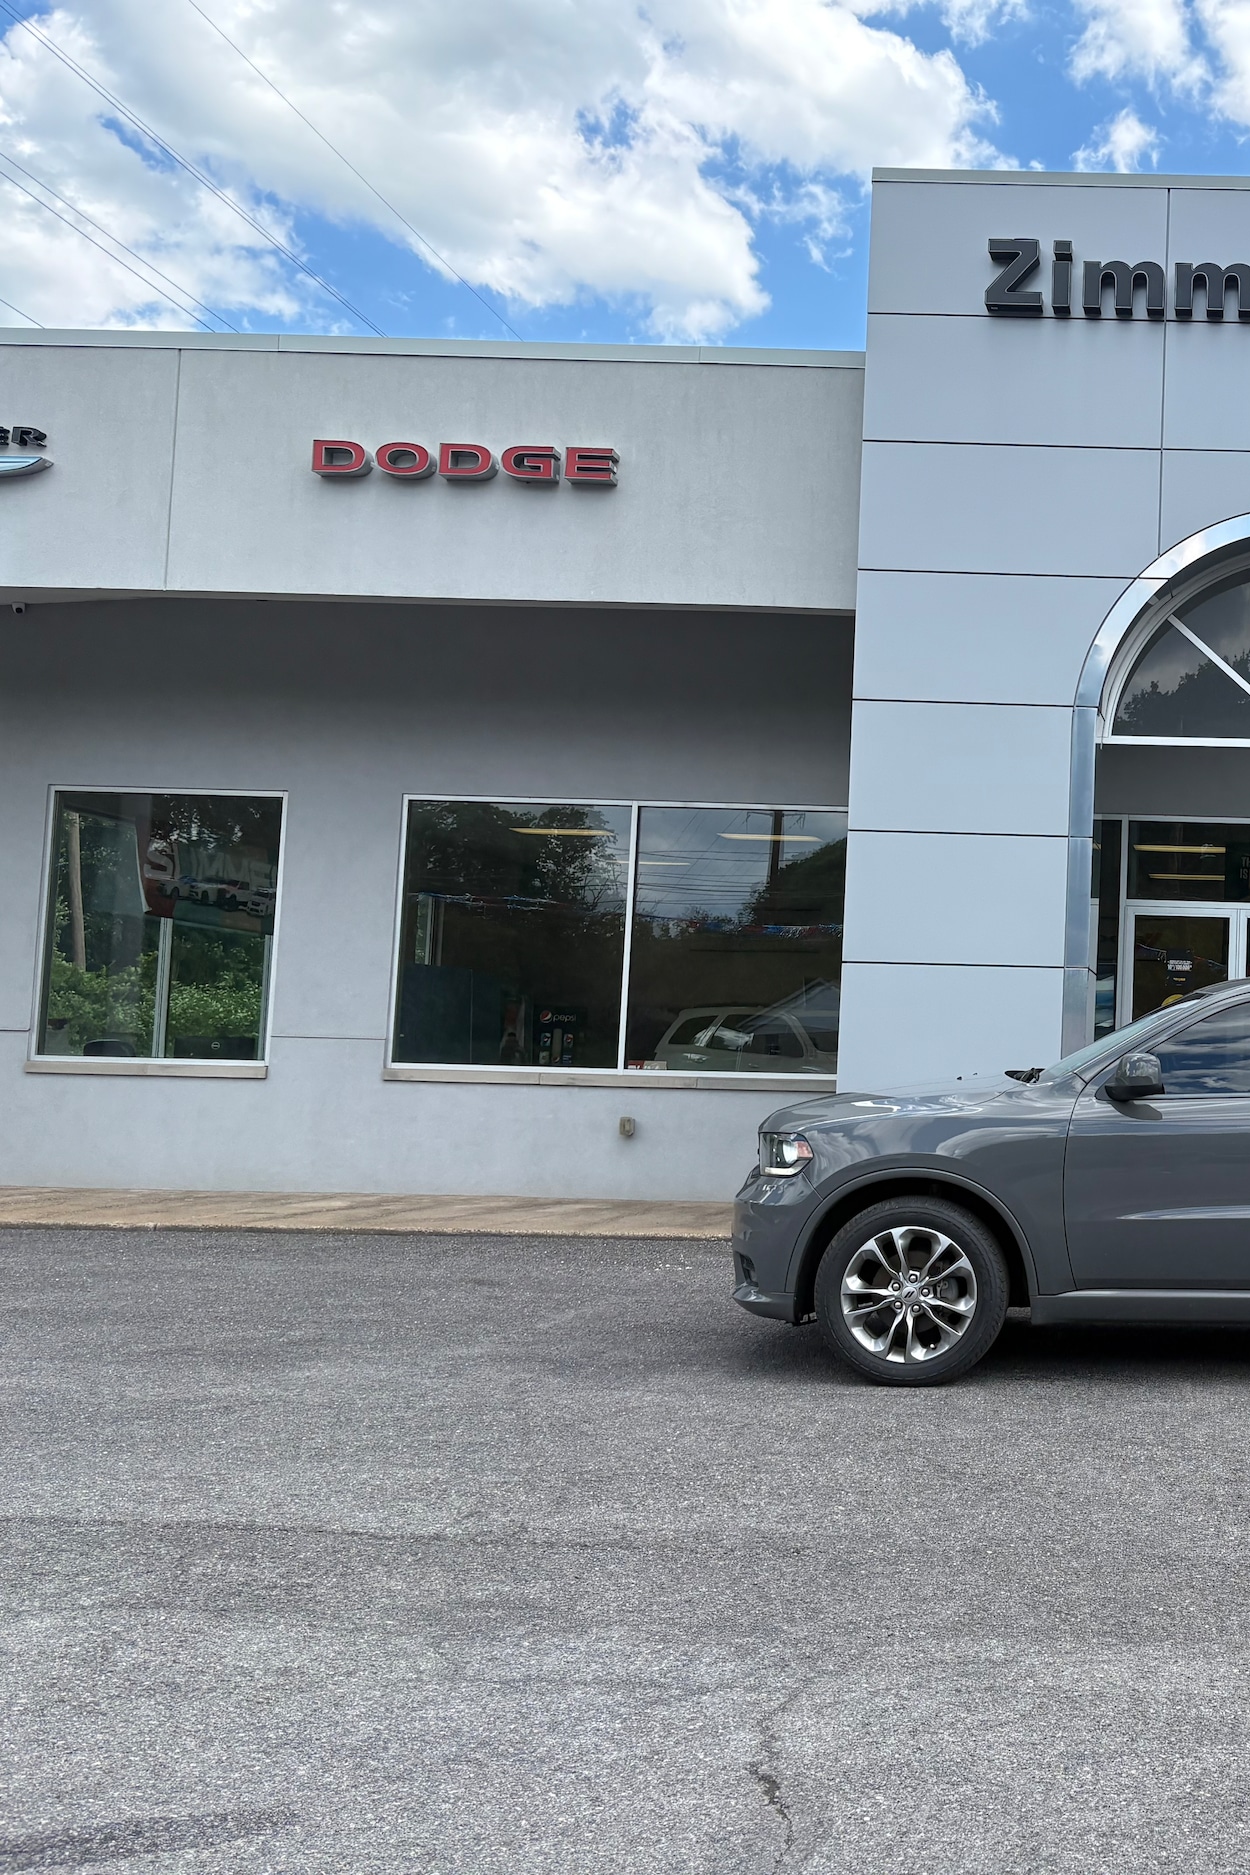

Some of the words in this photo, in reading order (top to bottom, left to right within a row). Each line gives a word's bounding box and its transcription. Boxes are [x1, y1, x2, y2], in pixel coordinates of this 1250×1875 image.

[311, 438, 620, 486] DODGE
[1240, 868, 1248, 879] IS
[553, 1013, 577, 1023] pepsi
